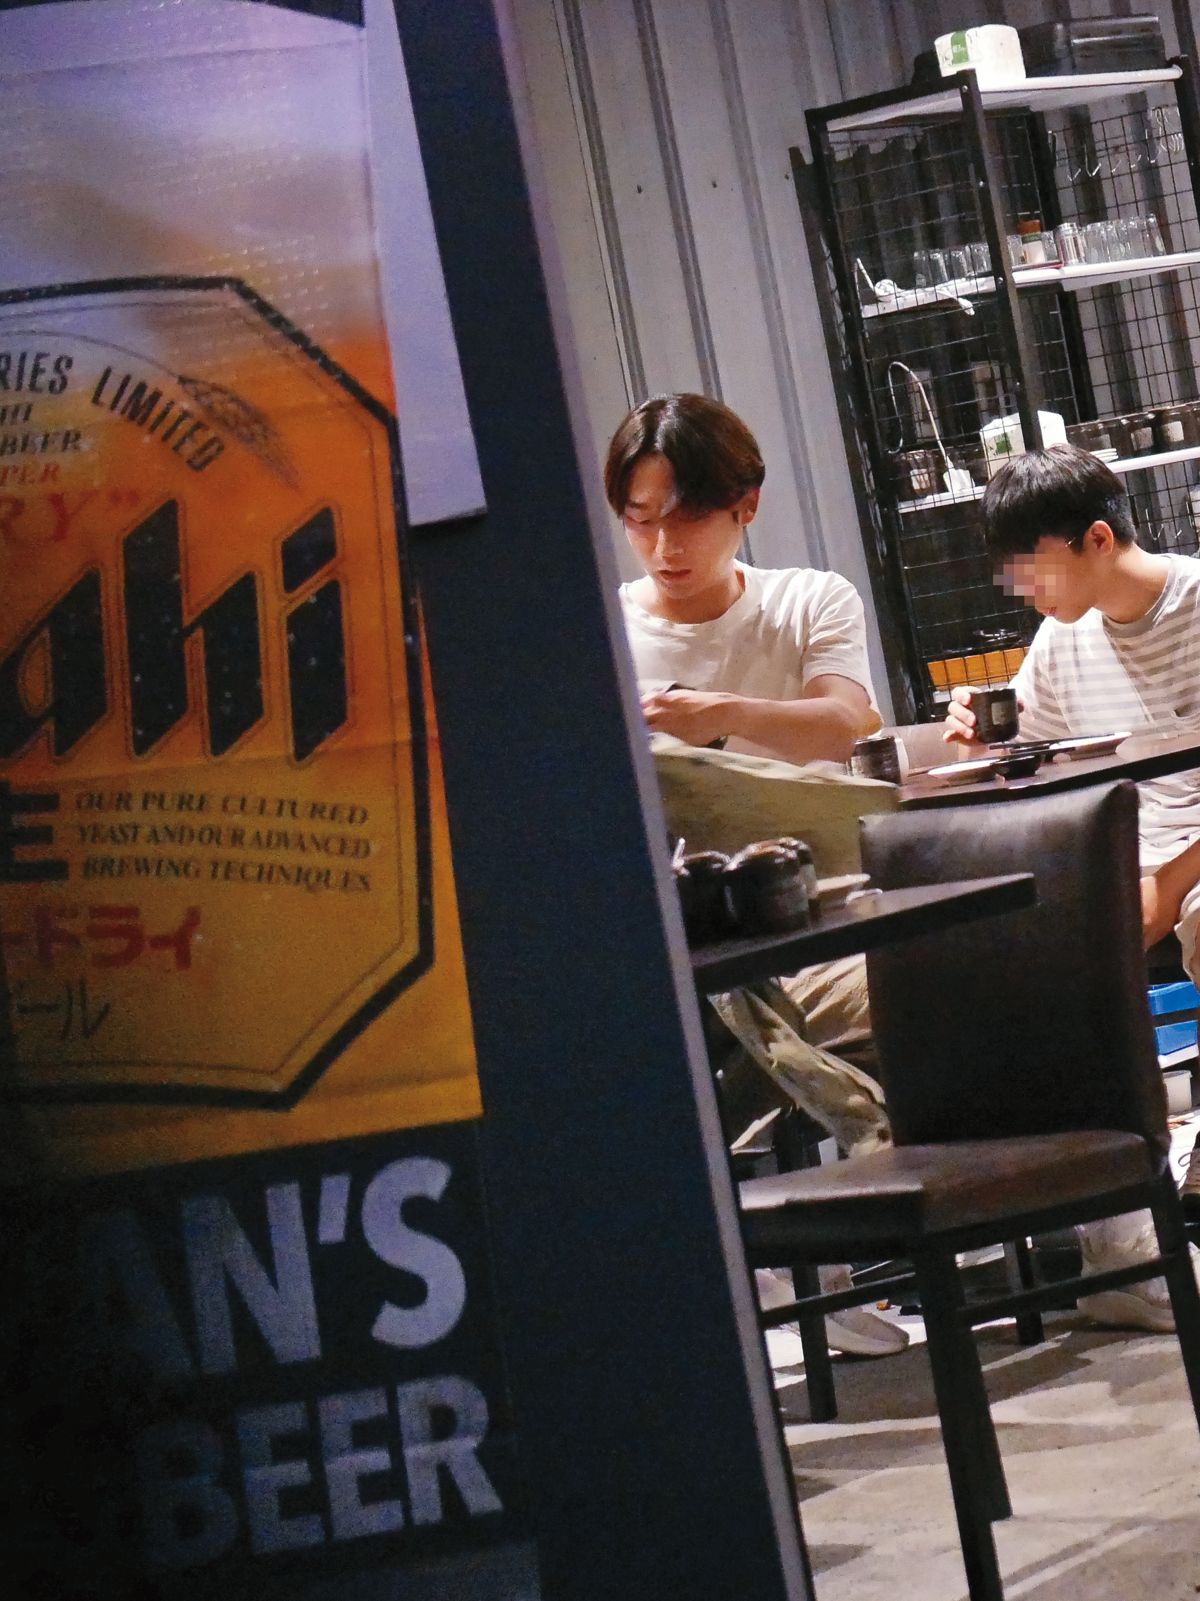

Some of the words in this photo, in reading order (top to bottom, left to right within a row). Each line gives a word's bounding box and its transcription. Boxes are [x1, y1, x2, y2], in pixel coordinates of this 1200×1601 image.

[91, 366, 225, 472] LIMITED
[75, 791, 133, 813] OUR
[142, 791, 210, 813] PURE
[221, 794, 369, 824] CULTURED
[77, 824, 142, 845] YEAST
[146, 825, 196, 846] AND
[199, 824, 246, 848] OUR
[251, 830, 371, 859] ADVANCED
[82, 857, 202, 881] BREWING
[211, 860, 371, 892] TECHNIQUES
[137, 1374, 505, 1571] BEER
